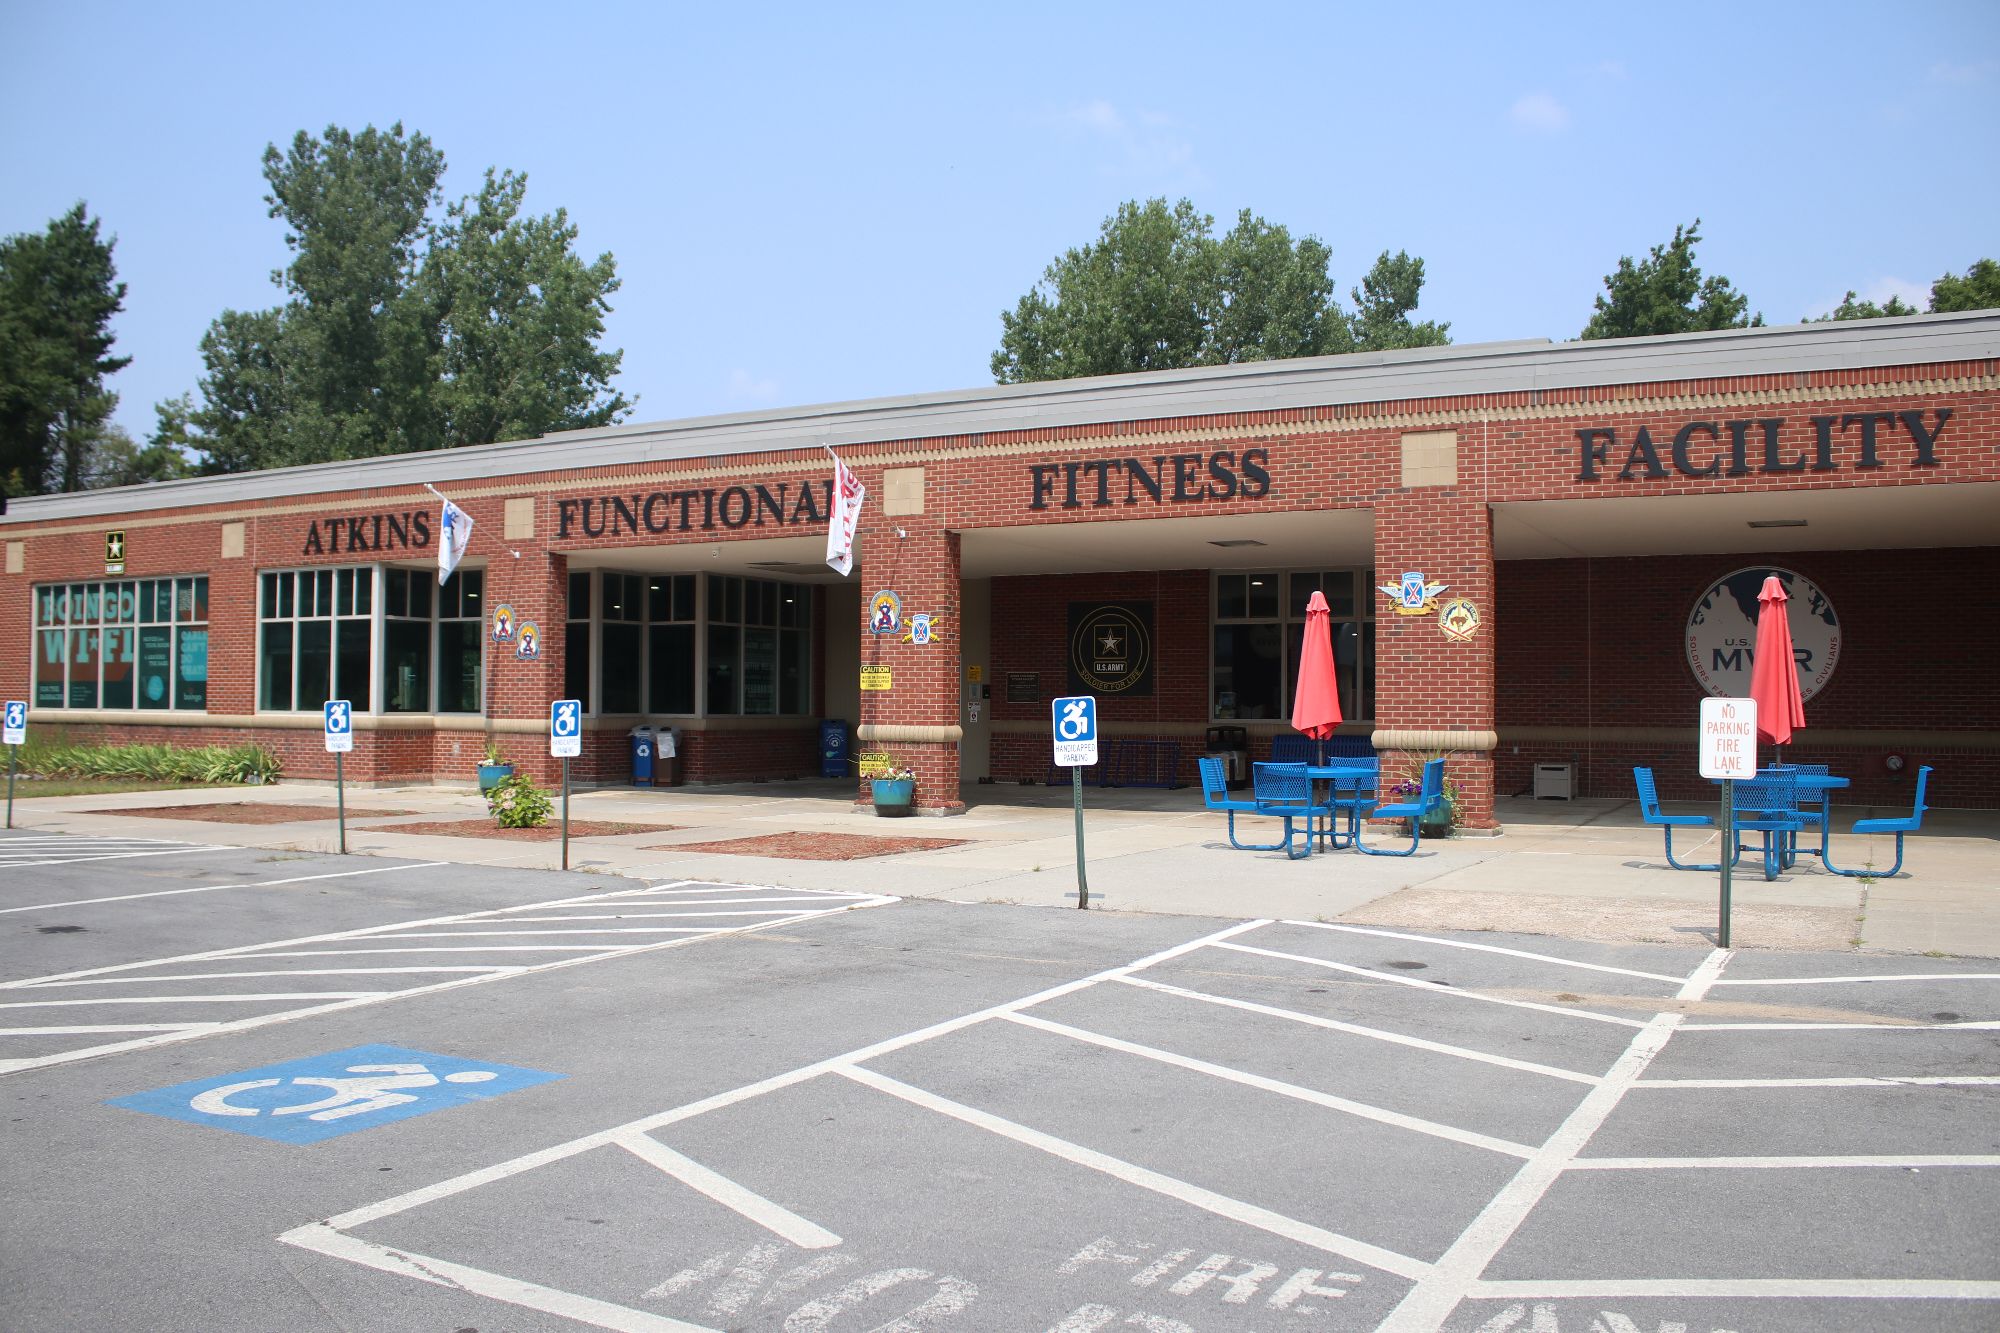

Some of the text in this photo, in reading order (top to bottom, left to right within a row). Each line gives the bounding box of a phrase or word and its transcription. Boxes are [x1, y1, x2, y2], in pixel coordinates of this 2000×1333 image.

[303, 511, 431, 556] ATKINS
[1028, 448, 1271, 510] FITNESS
[1575, 408, 1954, 482] FACILITY
[1725, 638, 1752, 647] U.S.
[1689, 635, 1710, 683] SOLDIERS
[1815, 636, 1838, 685] CIVILIANS
[1712, 648, 1813, 672] MR
[1080, 670, 1141, 690] SOLDIER FOR LIFE
[1721, 705, 1736, 719] NO
[1707, 721, 1750, 736] PARKING
[1055, 743, 1096, 753] HANDICAPPED
[1717, 738, 1740, 753] FIRE
[1063, 753, 1089, 763] PARKING
[1714, 756, 1742, 770] LANE
[1055, 1235, 1366, 1315] FIRE
